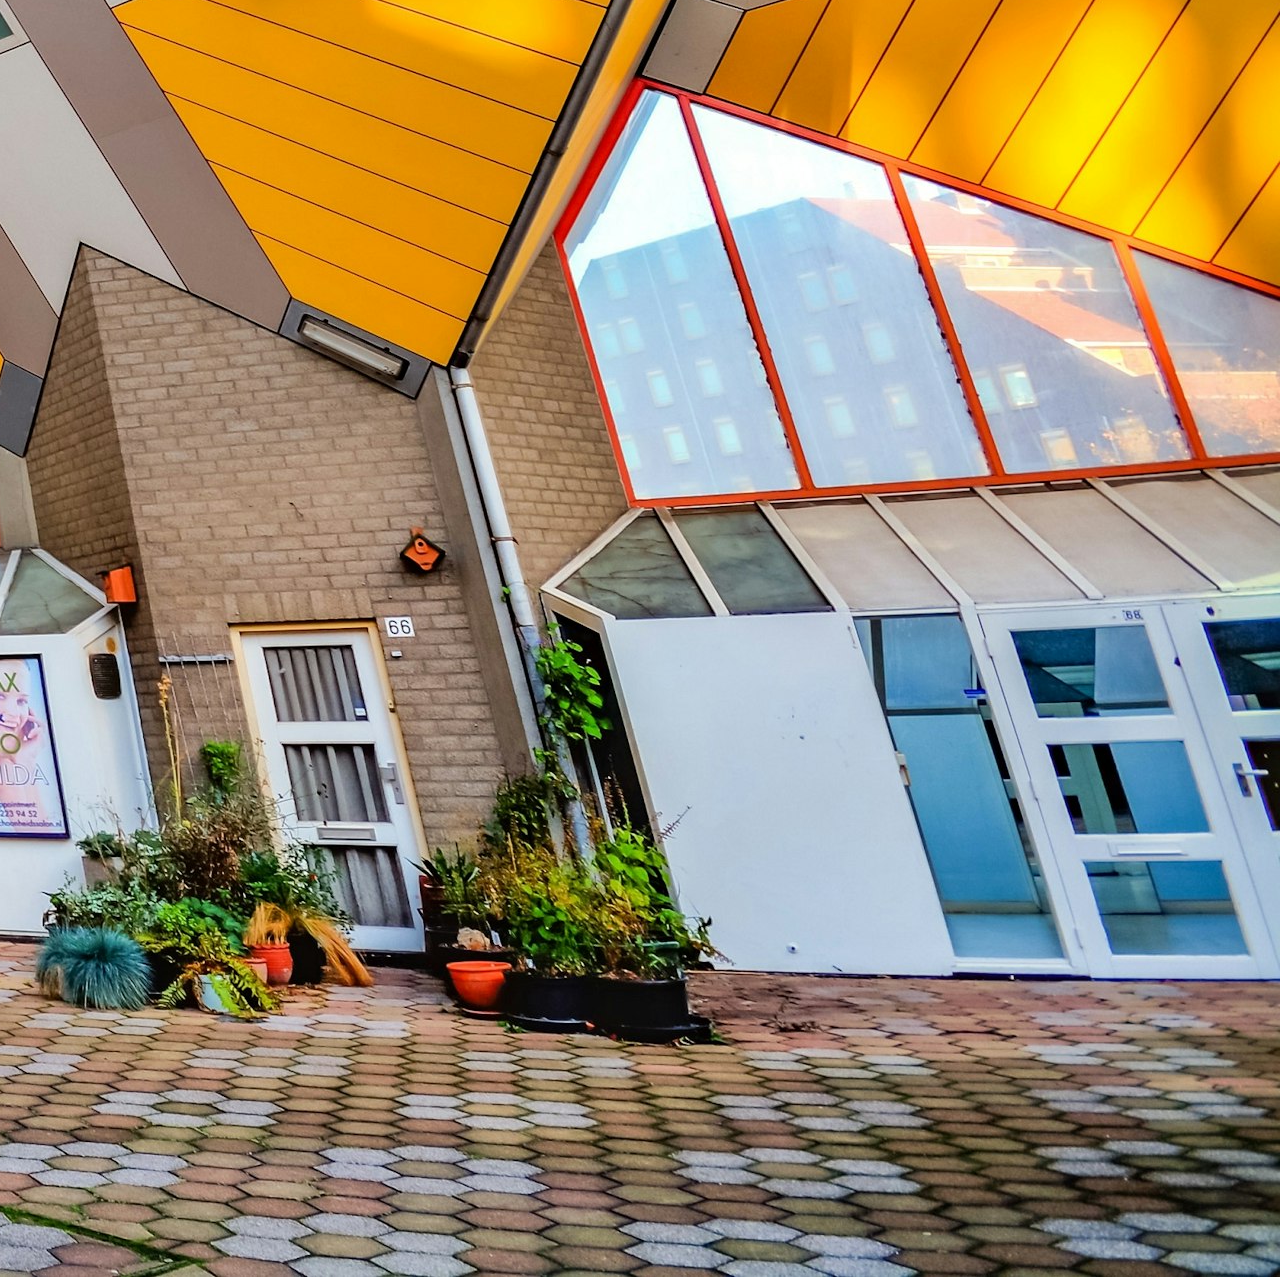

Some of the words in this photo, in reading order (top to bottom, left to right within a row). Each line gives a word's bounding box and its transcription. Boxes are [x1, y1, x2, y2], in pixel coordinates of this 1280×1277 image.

[1125, 610, 1141, 620] 68
[388, 619, 411, 635] 66
[28, 810, 38, 818] 52
